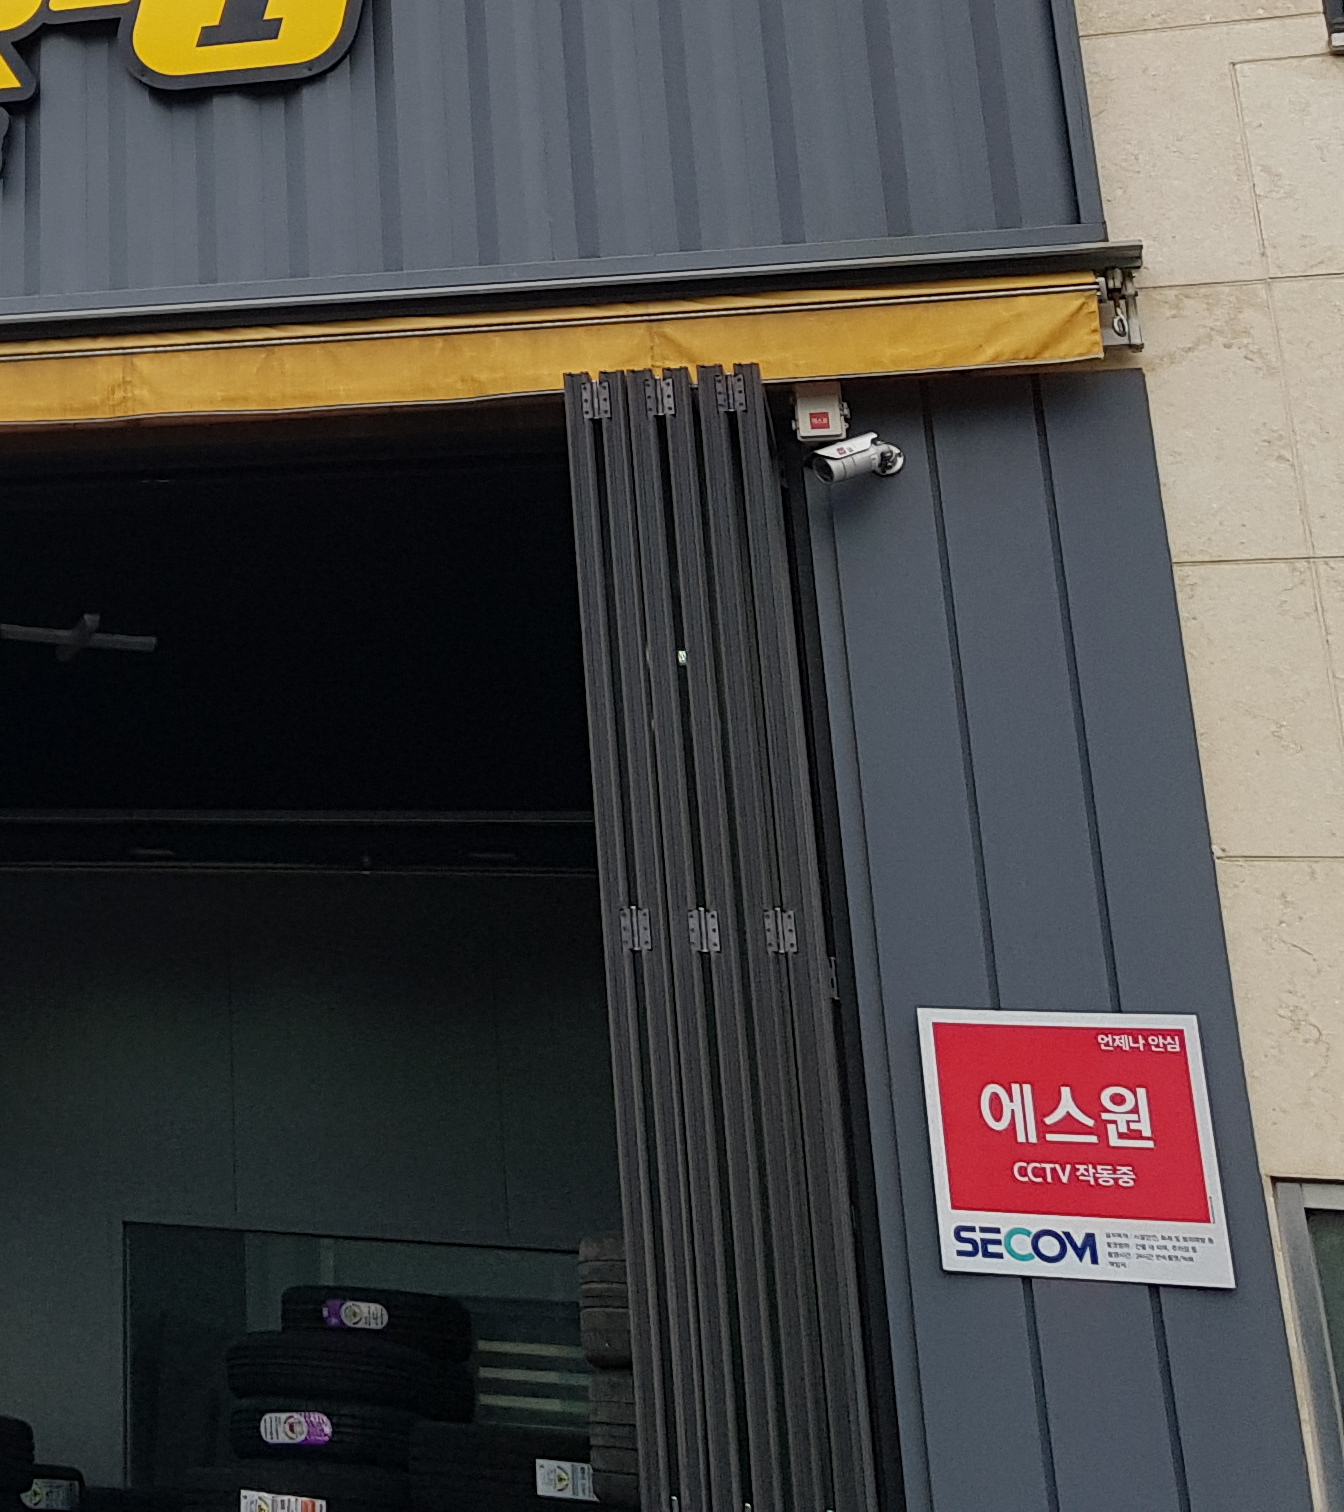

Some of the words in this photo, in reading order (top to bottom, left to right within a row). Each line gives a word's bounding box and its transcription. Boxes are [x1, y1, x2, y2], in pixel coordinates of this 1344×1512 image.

[1097, 1033, 1146, 1052] 언제나
[1149, 1035, 1181, 1053] 안심
[979, 1082, 1156, 1149] 에스원
[1013, 1161, 1072, 1185] CCTV
[1075, 1163, 1138, 1187] 작동중
[952, 1224, 1100, 1266] SECOM
